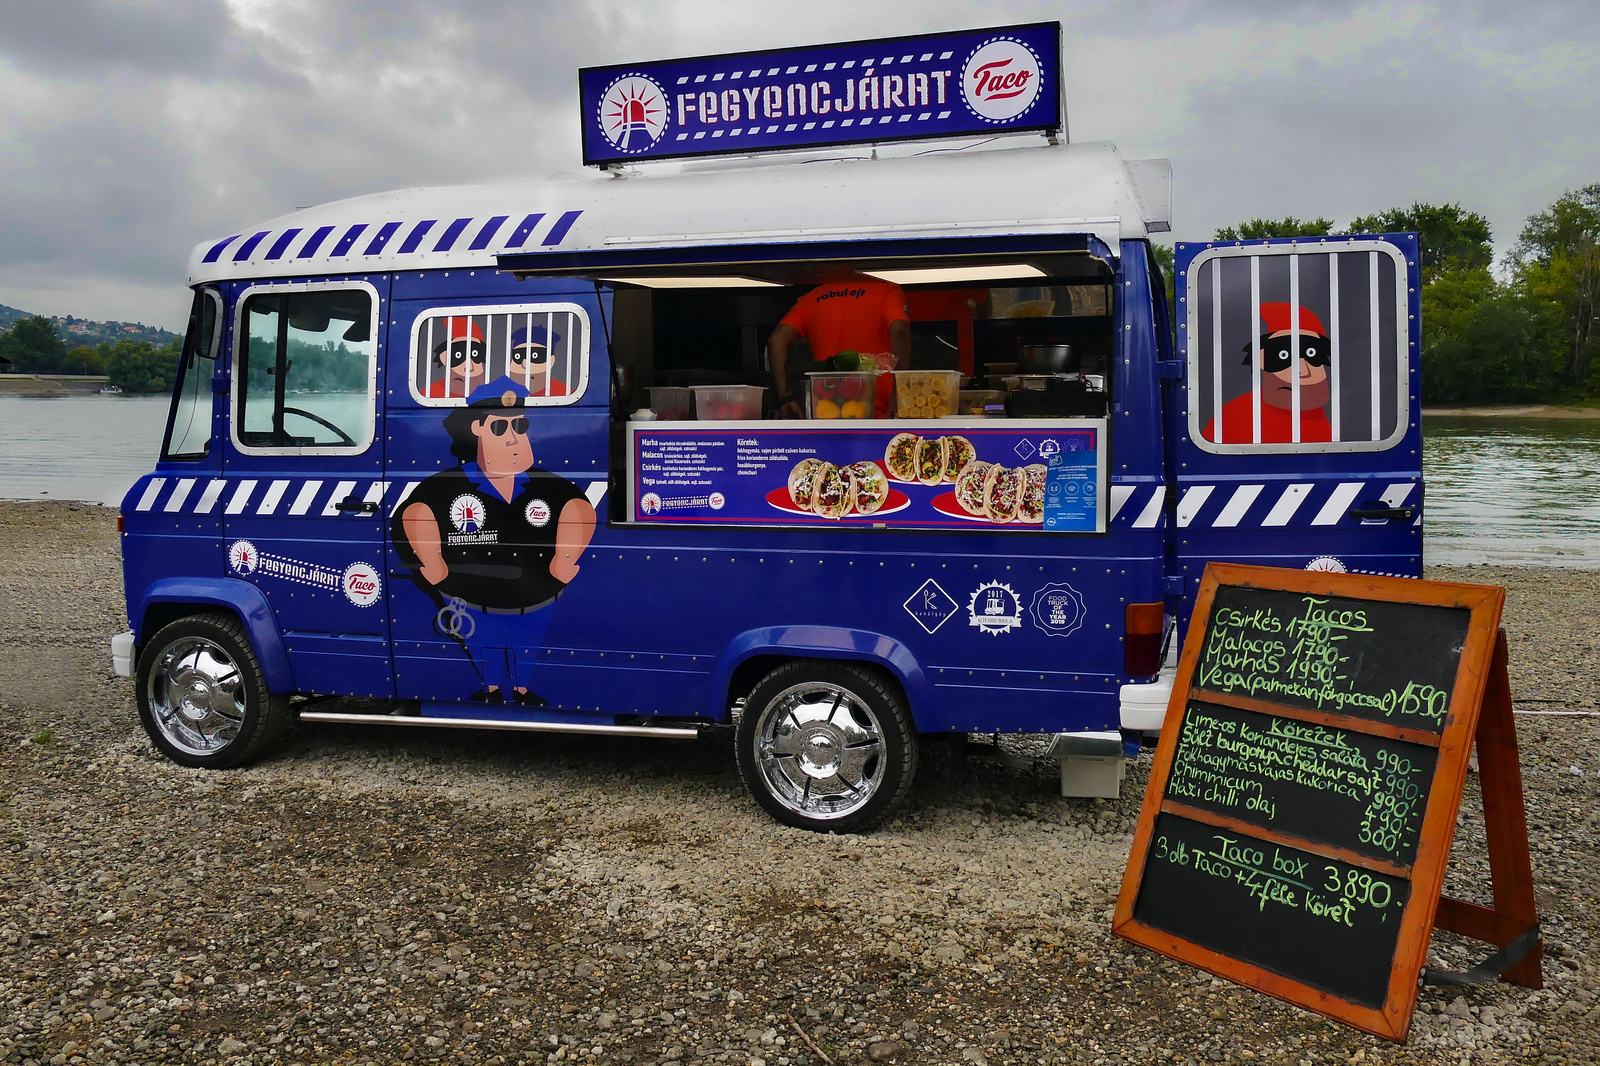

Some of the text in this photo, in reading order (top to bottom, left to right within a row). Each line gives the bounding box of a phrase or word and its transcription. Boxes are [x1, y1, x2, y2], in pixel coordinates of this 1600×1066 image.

[973, 57, 1034, 98] Taco
[816, 288, 849, 302] rabul
[641, 438, 658, 446] Marha
[642, 451, 663, 459] Malacos
[642, 463, 661, 471] Csirkés
[642, 476, 655, 486] Vega
[529, 506, 547, 518] Taco
[348, 573, 376, 591] Taco
[987, 590, 1004, 598] 2017
[1215, 606, 1281, 633] Csirkés
[1302, 596, 1367, 628] Tacos
[1211, 625, 1287, 657] Malacos
[1270, 717, 1348, 748] Köretek
[1182, 725, 1214, 748] Sült
[1216, 732, 1284, 766] burgonya
[1282, 753, 1347, 781] cheddar
[1346, 769, 1383, 796] sajt
[1245, 793, 1276, 821] olaj
[1155, 835, 1168, 859] 3
[1169, 840, 1190, 866] db
[1191, 848, 1232, 879] Taco
[1212, 835, 1264, 866] Taco
[1272, 847, 1309, 880] box
